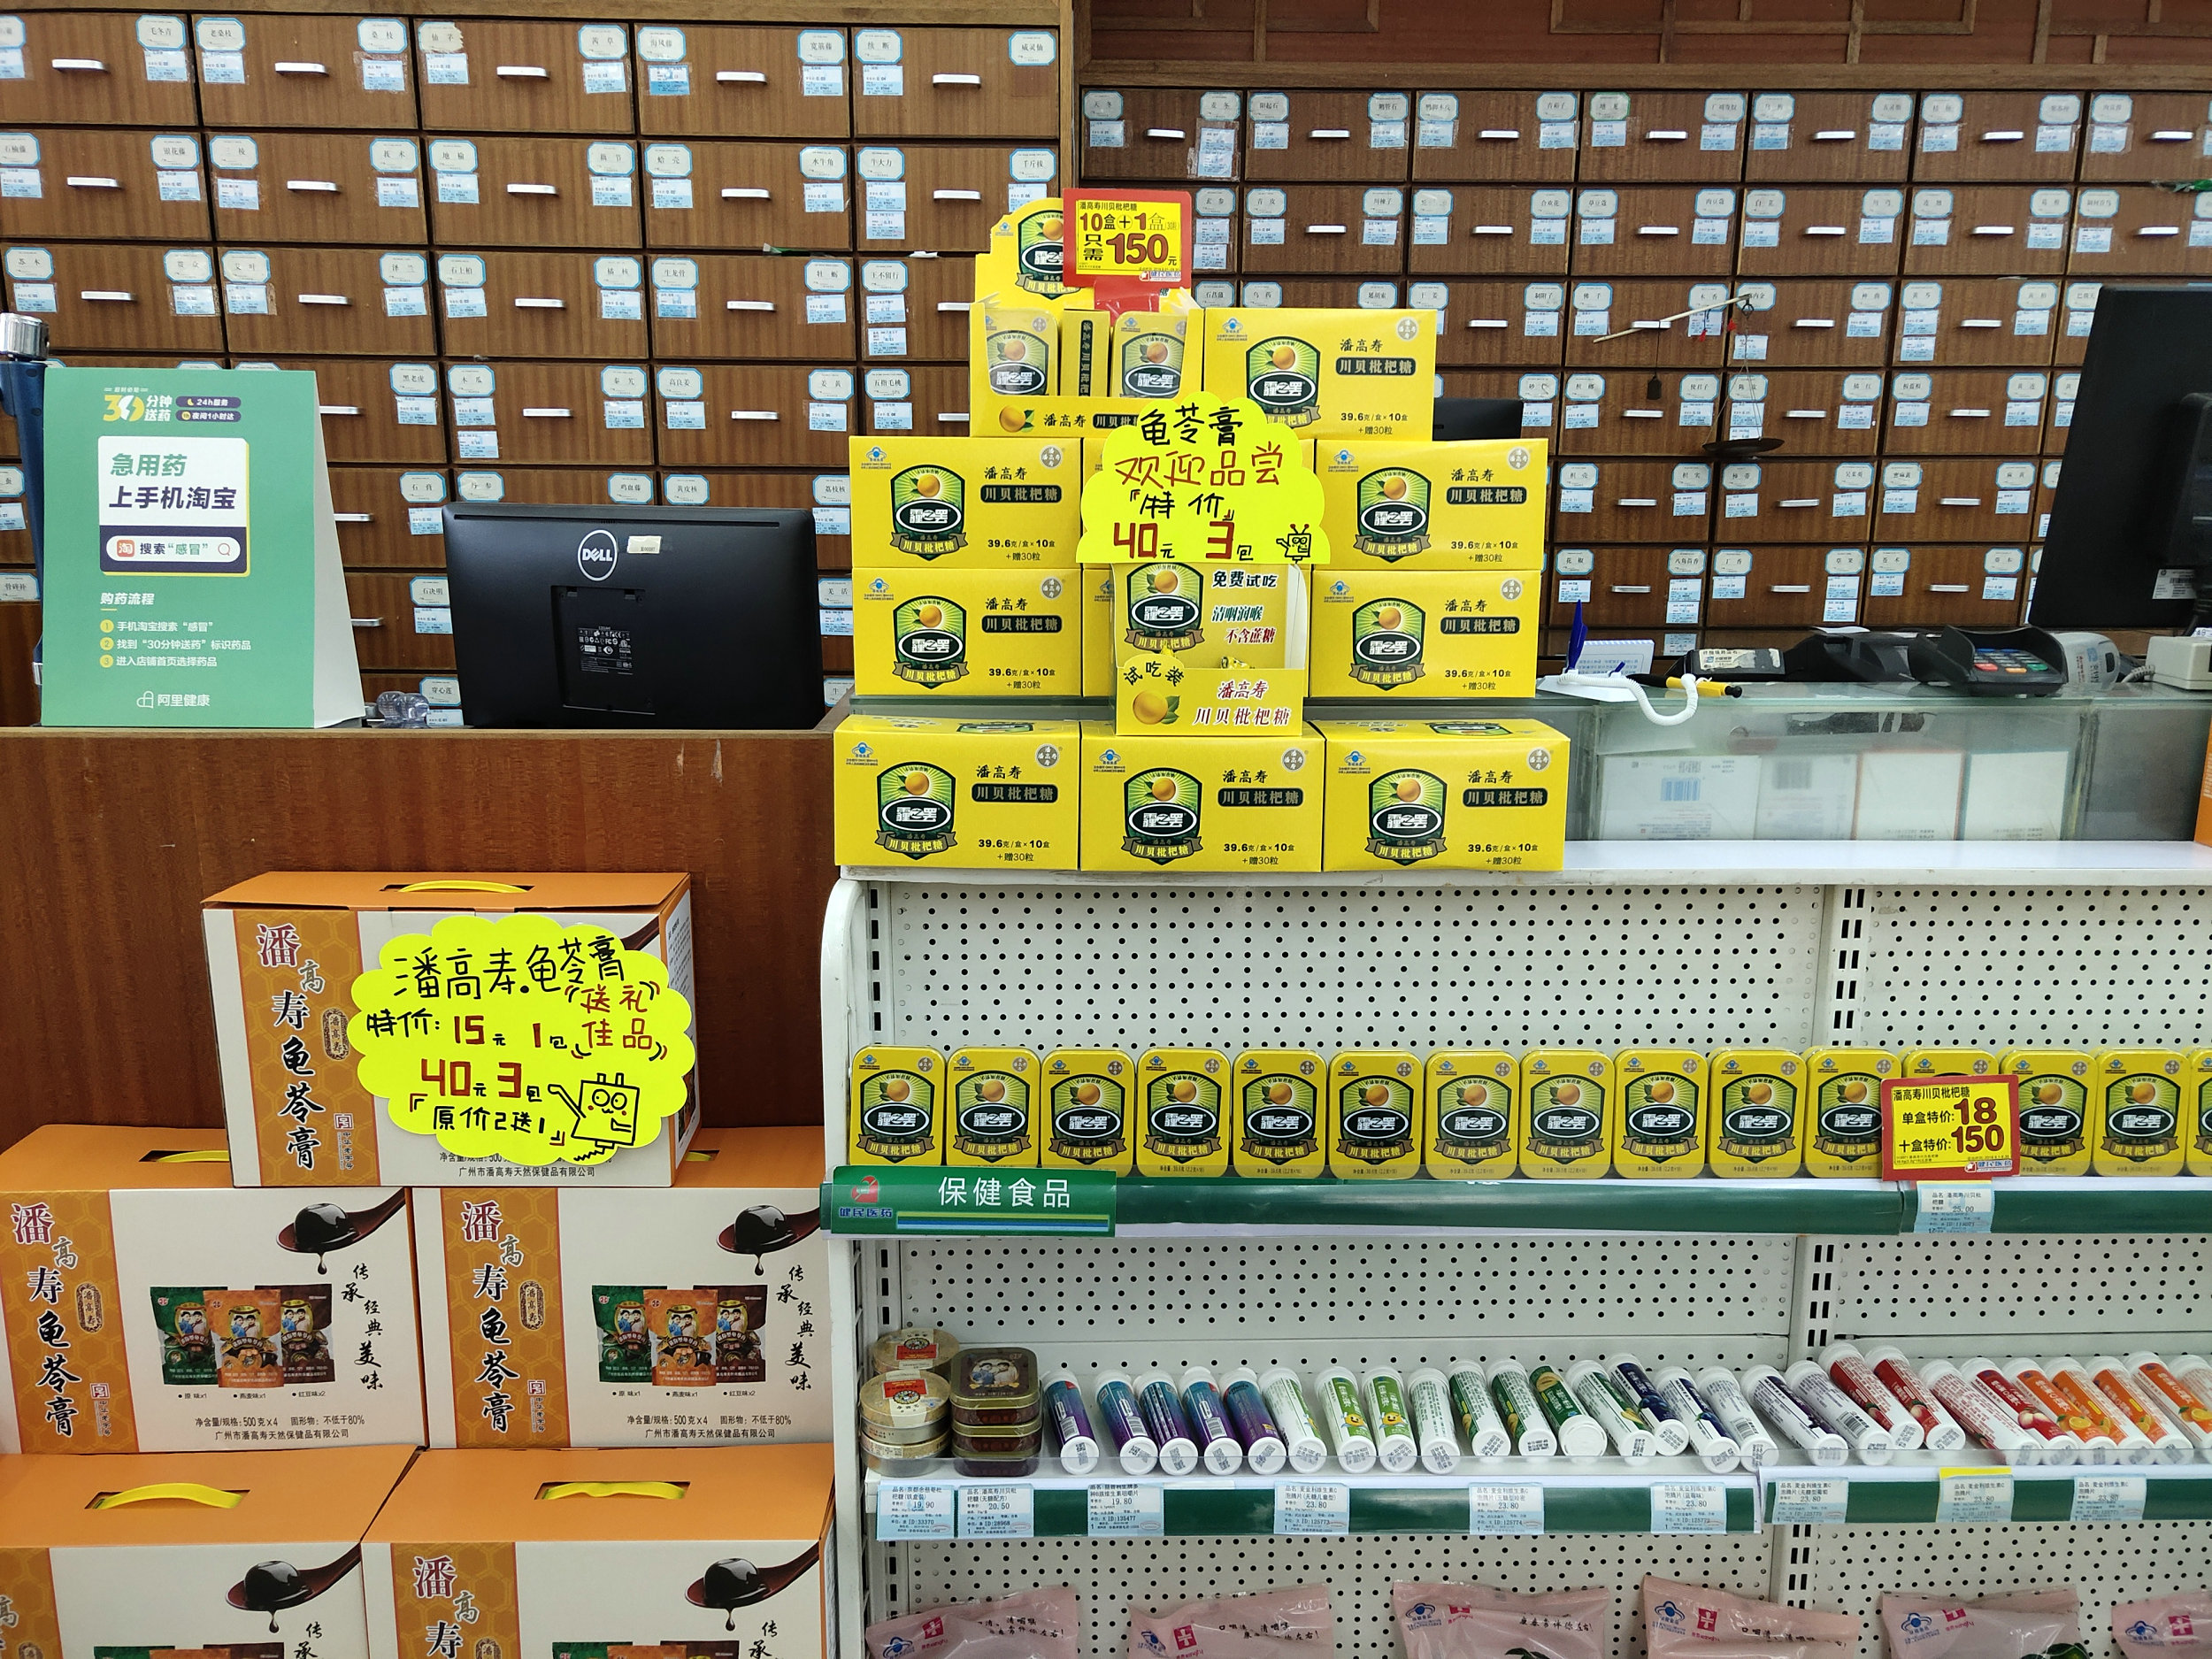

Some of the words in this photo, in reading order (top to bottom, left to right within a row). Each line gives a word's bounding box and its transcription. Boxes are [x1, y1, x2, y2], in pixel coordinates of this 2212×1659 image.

[1079, 202, 1138, 211] 潘高寿川贝枇杷糖
[1340, 338, 1383, 352] 潘高寿
[1340, 359, 1412, 373] 川贝枇杷糖
[1043, 414, 1087, 427] 潘高寿
[1140, 403, 1243, 446] 龟苓膏
[111, 453, 188, 477] 急用药
[1115, 441, 1283, 488] 欢迎品尝
[984, 466, 1027, 480] 潘高寿
[1451, 468, 1494, 482] 潘高寿
[109, 487, 237, 510] 上手机淘宝
[984, 487, 1057, 501] 川贝枇杷糖
[1449, 488, 1524, 503] 川贝枇杷糖
[1113, 522, 1175, 559] 40元
[1205, 521, 1254, 561] 3包
[582, 548, 612, 562] DELL
[1212, 571, 1278, 588] 免费试吃
[100, 592, 154, 605] 购药流程
[985, 597, 1028, 611] 潘高寿
[1445, 599, 1487, 612] 潘高寿
[1211, 606, 1264, 622] 清咽润喉
[985, 618, 1059, 632] 川贝枇杷糖
[1443, 618, 1517, 633] 川贝枇杷糖
[1225, 627, 1277, 644] 不含蔗糖
[117, 657, 218, 667] 进入店铺首页选择药品
[1124, 660, 1185, 687] 试吃装
[1217, 680, 1268, 699] 潘高寿
[157, 695, 211, 707] 阿里健康
[1193, 708, 1291, 726] 川贝枇杷糖
[975, 764, 1023, 780] 潘高寿
[1222, 769, 1268, 784] 潘高寿
[1467, 770, 1514, 784] 潘高寿
[976, 787, 1054, 801] 川贝枇杷糖
[1222, 790, 1299, 804] 川贝枇杷糖
[1467, 791, 1543, 805] 川贝枇杷糖
[454, 1016, 507, 1047] 15元
[256, 922, 326, 1171] 潘高寿龟苓膏
[421, 1058, 488, 1098] 40元
[1893, 1087, 1970, 1101] 潘高寿川贝枇杷糖
[1953, 1097, 1997, 1125] 18
[1950, 1125, 2004, 1153] 150
[869, 1141, 921, 1155] 川贝枇杷糖
[1254, 1144, 1305, 1156] 川贝枇杷糖
[2114, 1143, 2165, 1156] 川贝枇杷糖
[458, 1166, 595, 1179] 广州市潘高寿天然保健品有限公司
[938, 1176, 1071, 1208] 保健食品
[839, 1207, 893, 1217] 健民医药
[12, 1202, 81, 1438] 潘高寿龟苓膏
[461, 1199, 524, 1433] 潘高寿龟苓膏
[214, 1429, 349, 1440] 广州市潘高寿天然保健品有限公司
[645, 1428, 776, 1440] 广州市潘高寿天然保健品有限公司
